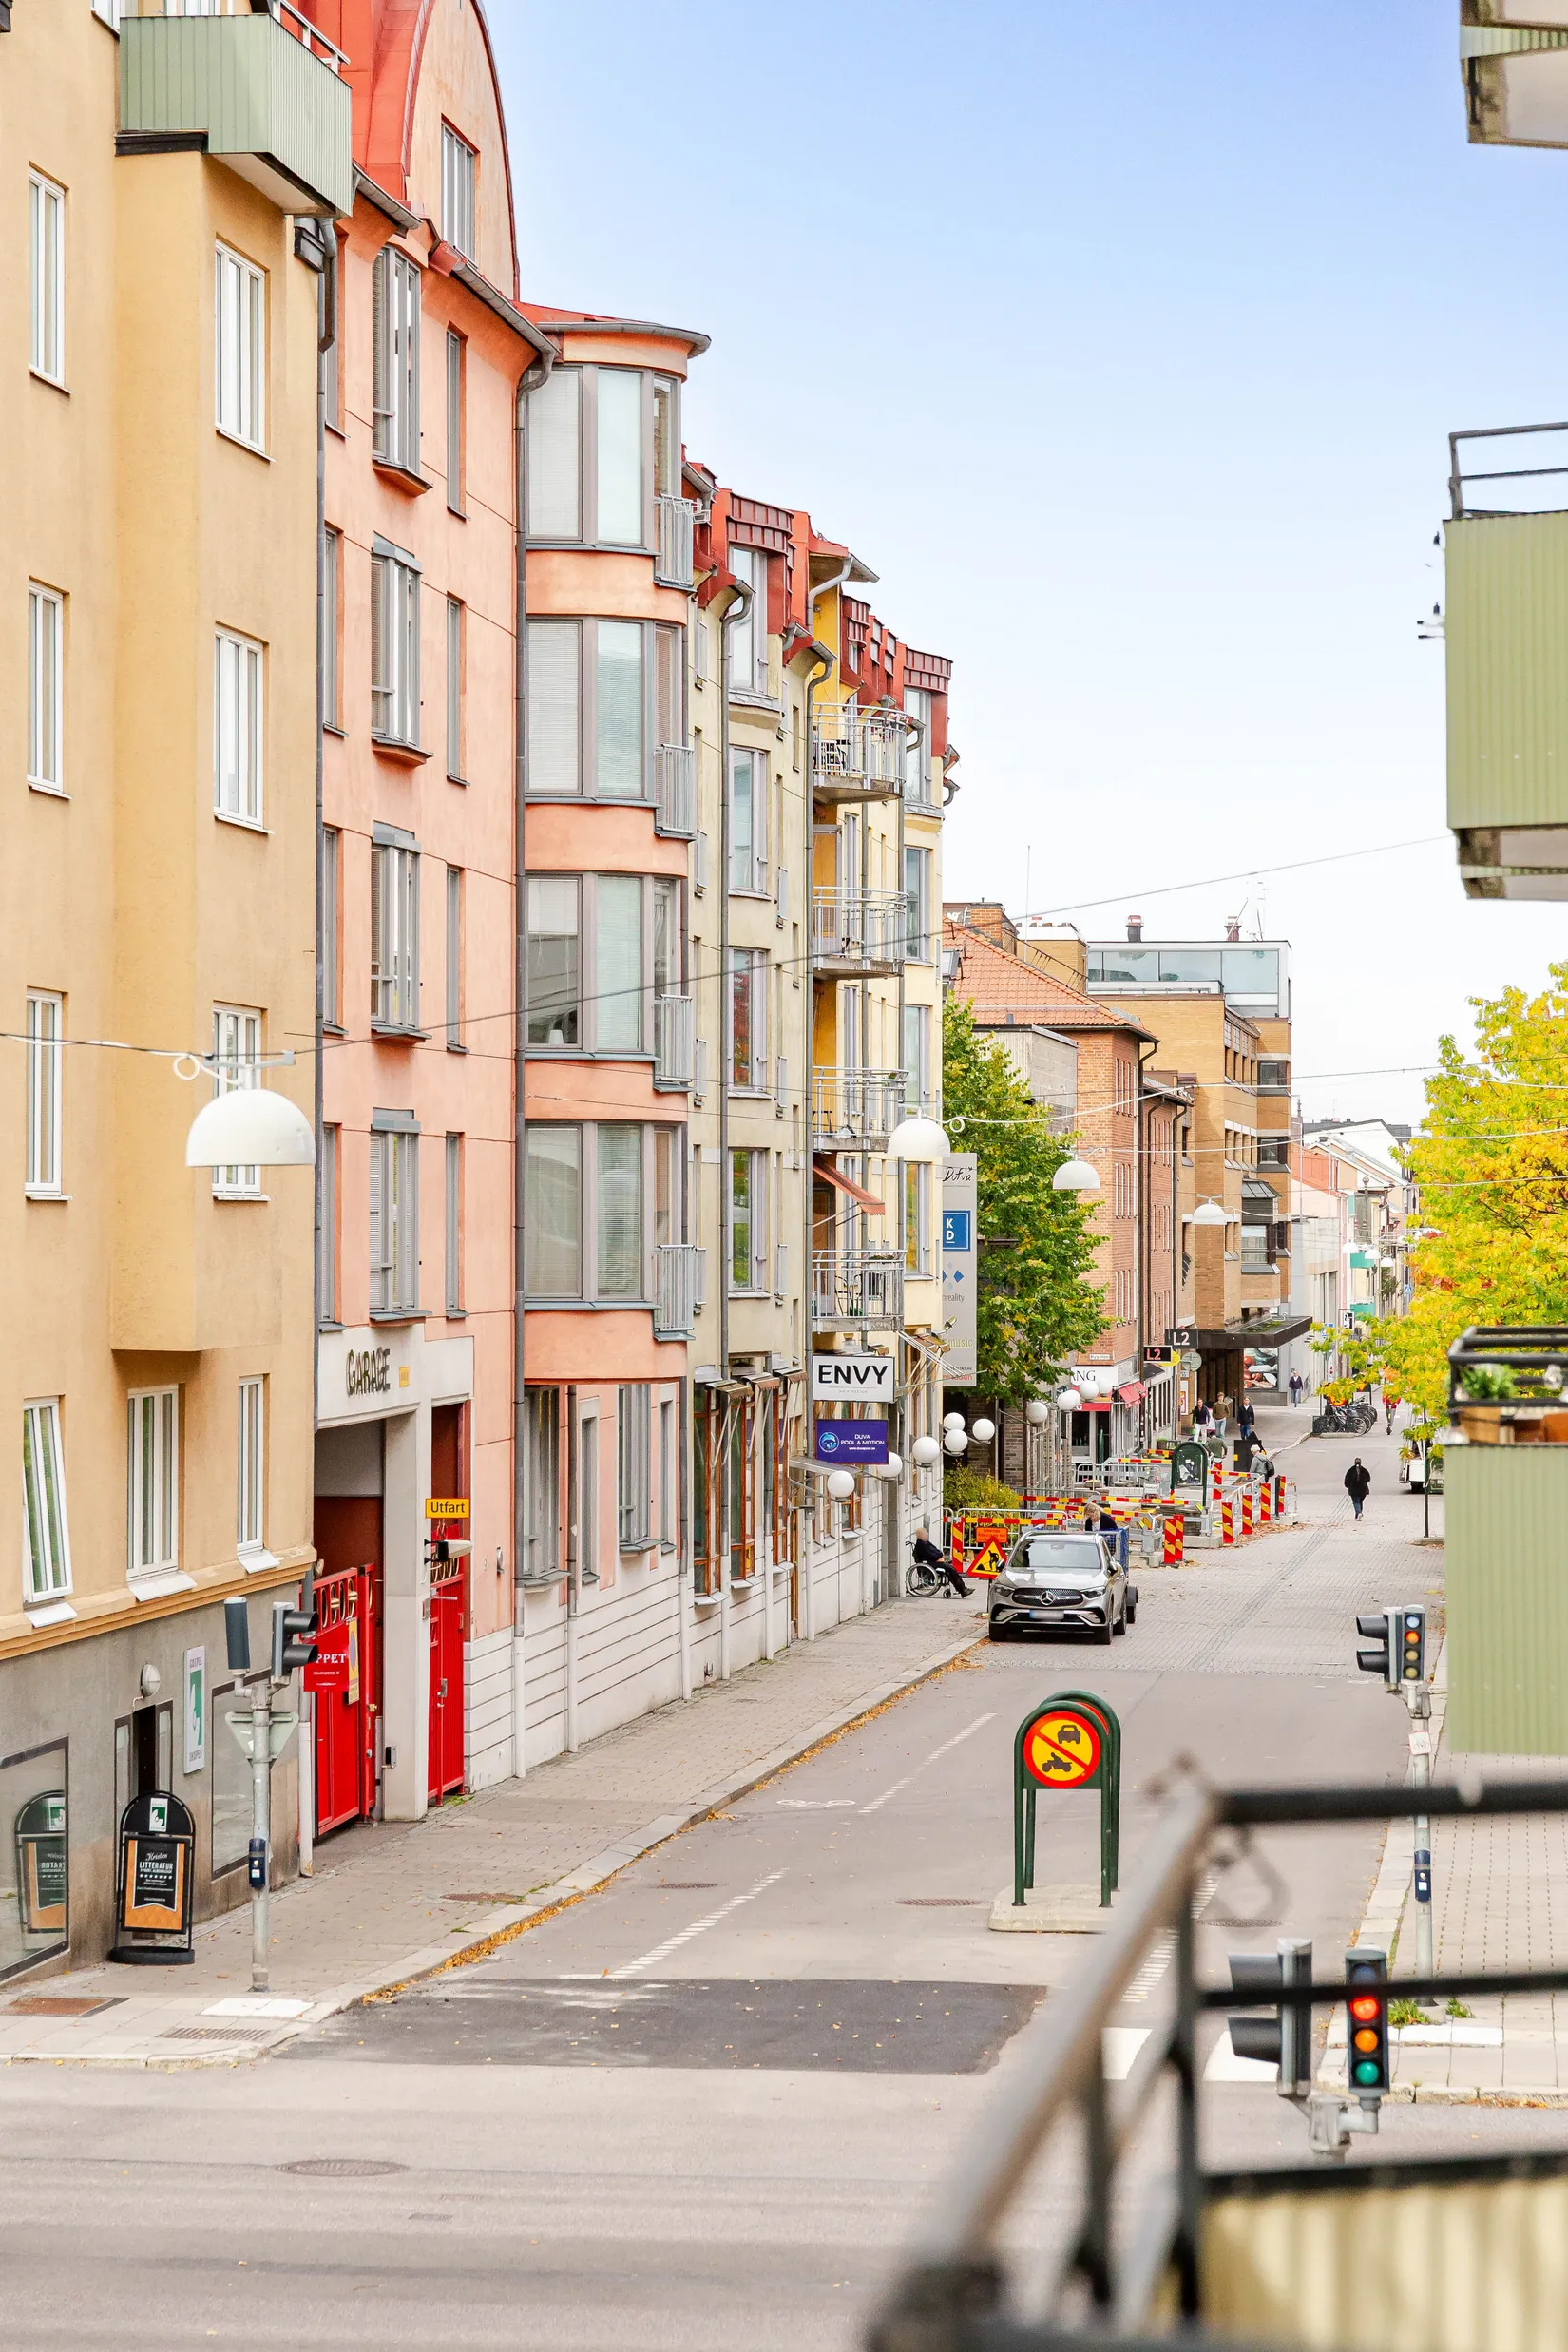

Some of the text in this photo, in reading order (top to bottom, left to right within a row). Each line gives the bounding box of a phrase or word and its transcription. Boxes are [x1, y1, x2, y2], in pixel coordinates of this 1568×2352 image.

[946, 1217, 954, 1229] K
[946, 1230, 955, 1241] D
[1173, 1331, 1191, 1346] L2
[1146, 1348, 1161, 1361] L2
[346, 1346, 391, 1396] GARAGE
[818, 1364, 889, 1385] ENVY
[430, 1501, 466, 1514] Utfart
[316, 1653, 347, 1664] PPET
[139, 1861, 174, 1870] LITTERATUR
